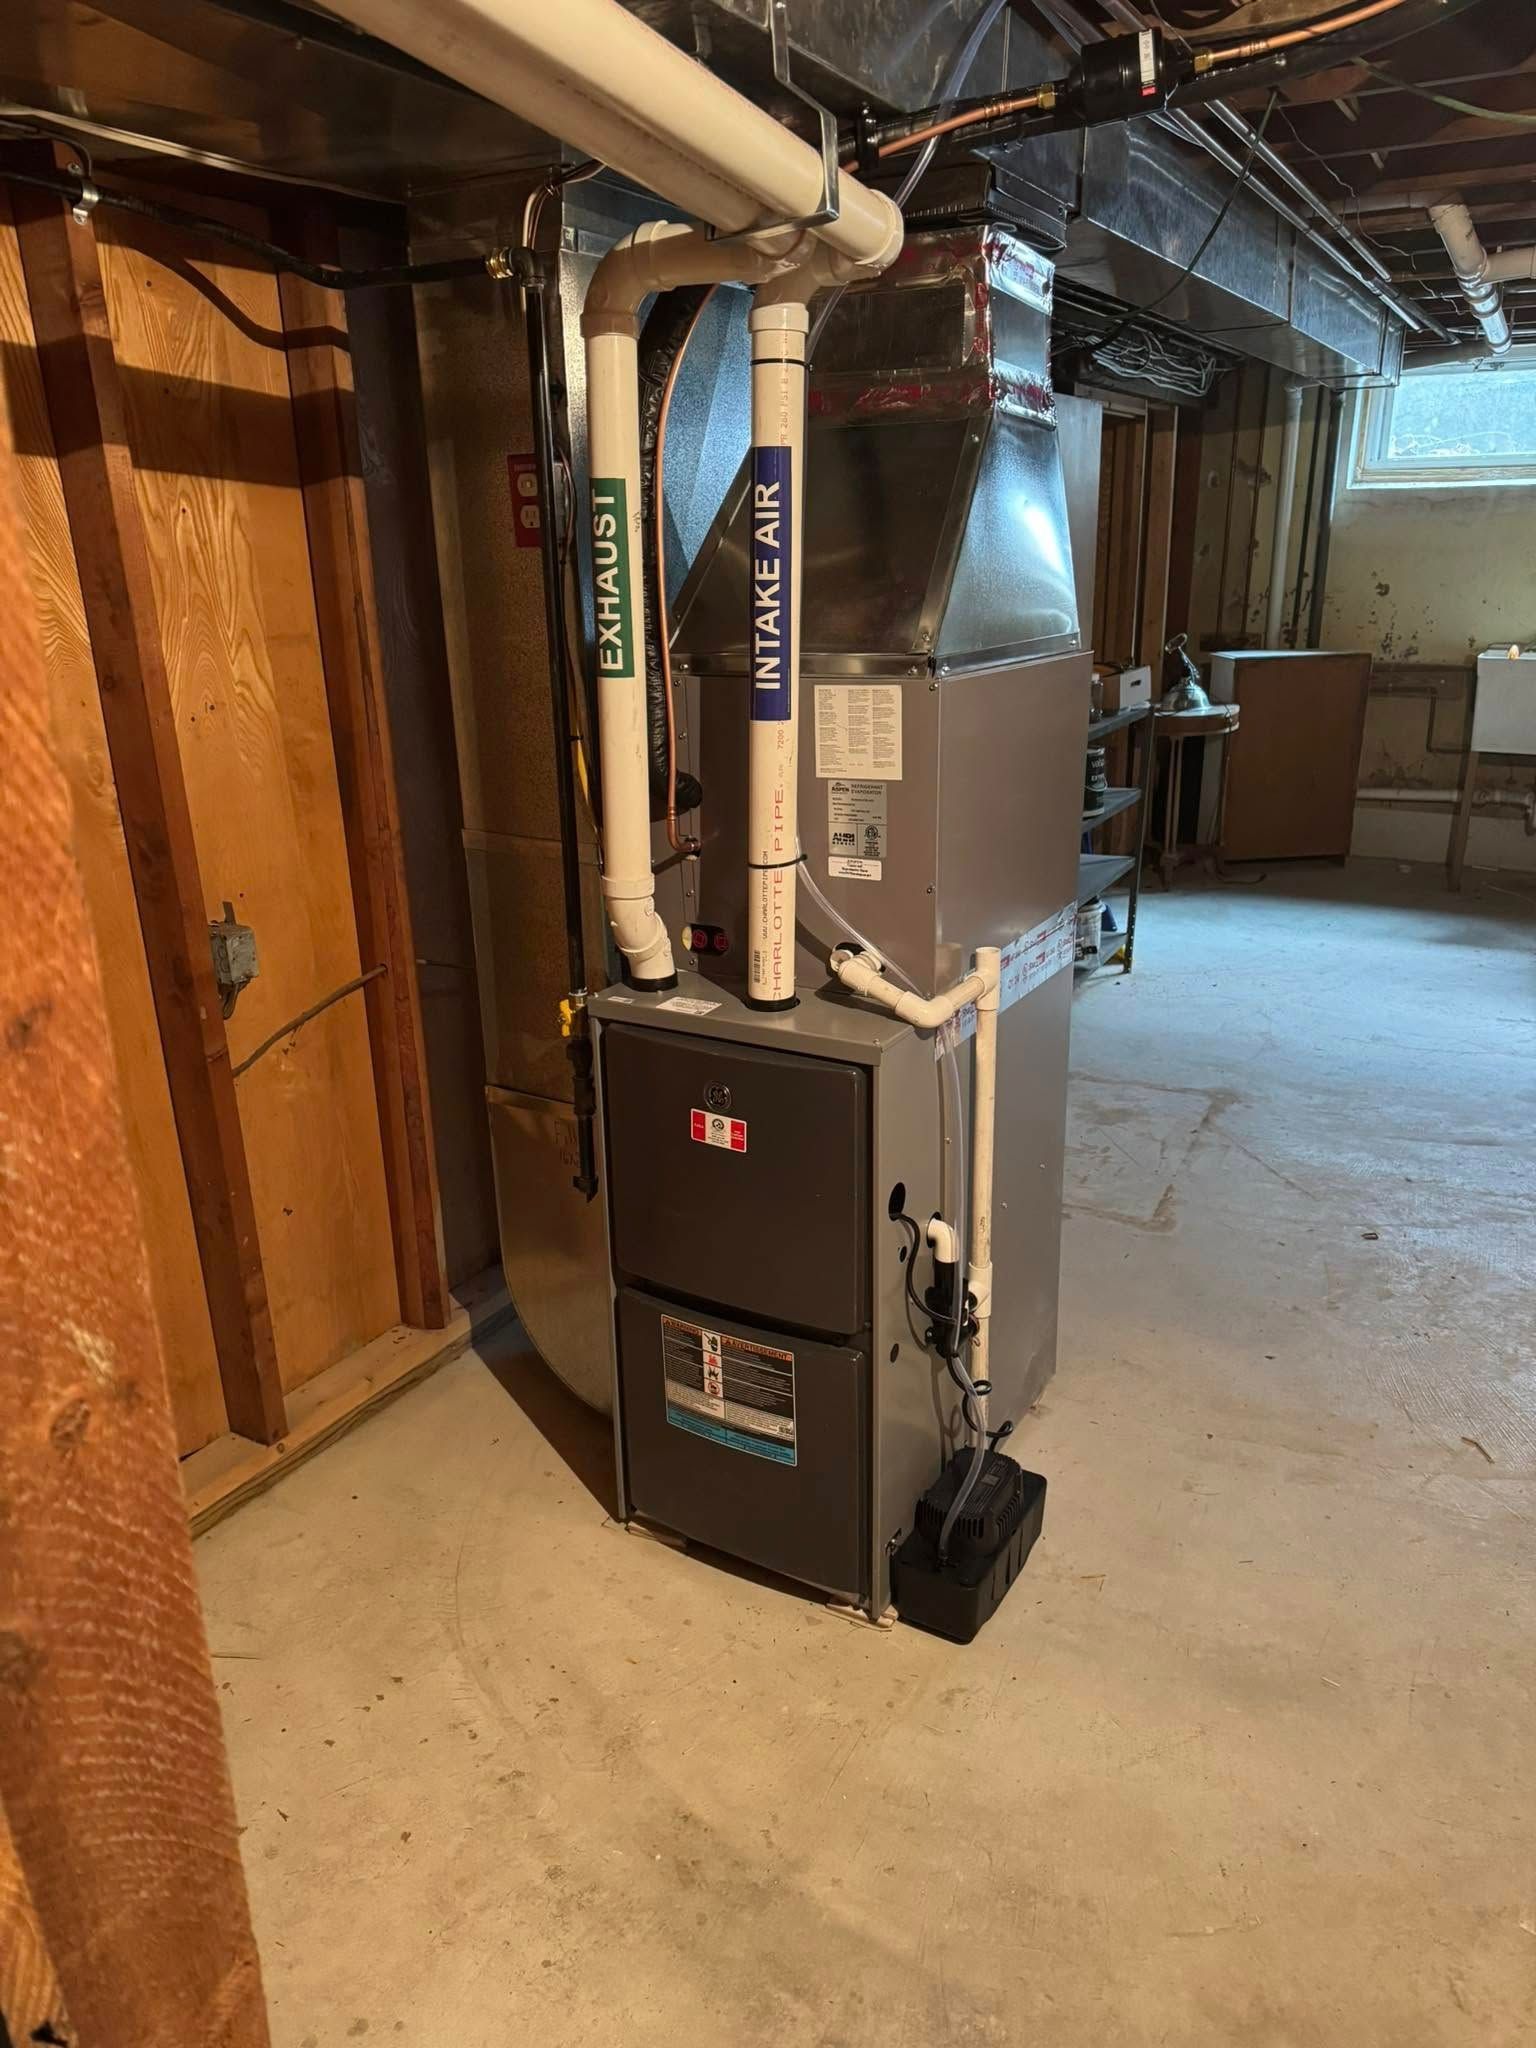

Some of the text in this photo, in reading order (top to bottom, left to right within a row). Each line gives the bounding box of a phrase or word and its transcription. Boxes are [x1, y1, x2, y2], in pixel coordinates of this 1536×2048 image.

[592, 488, 623, 670] EXHAUST
[754, 482, 781, 690] INTAKE AIR
